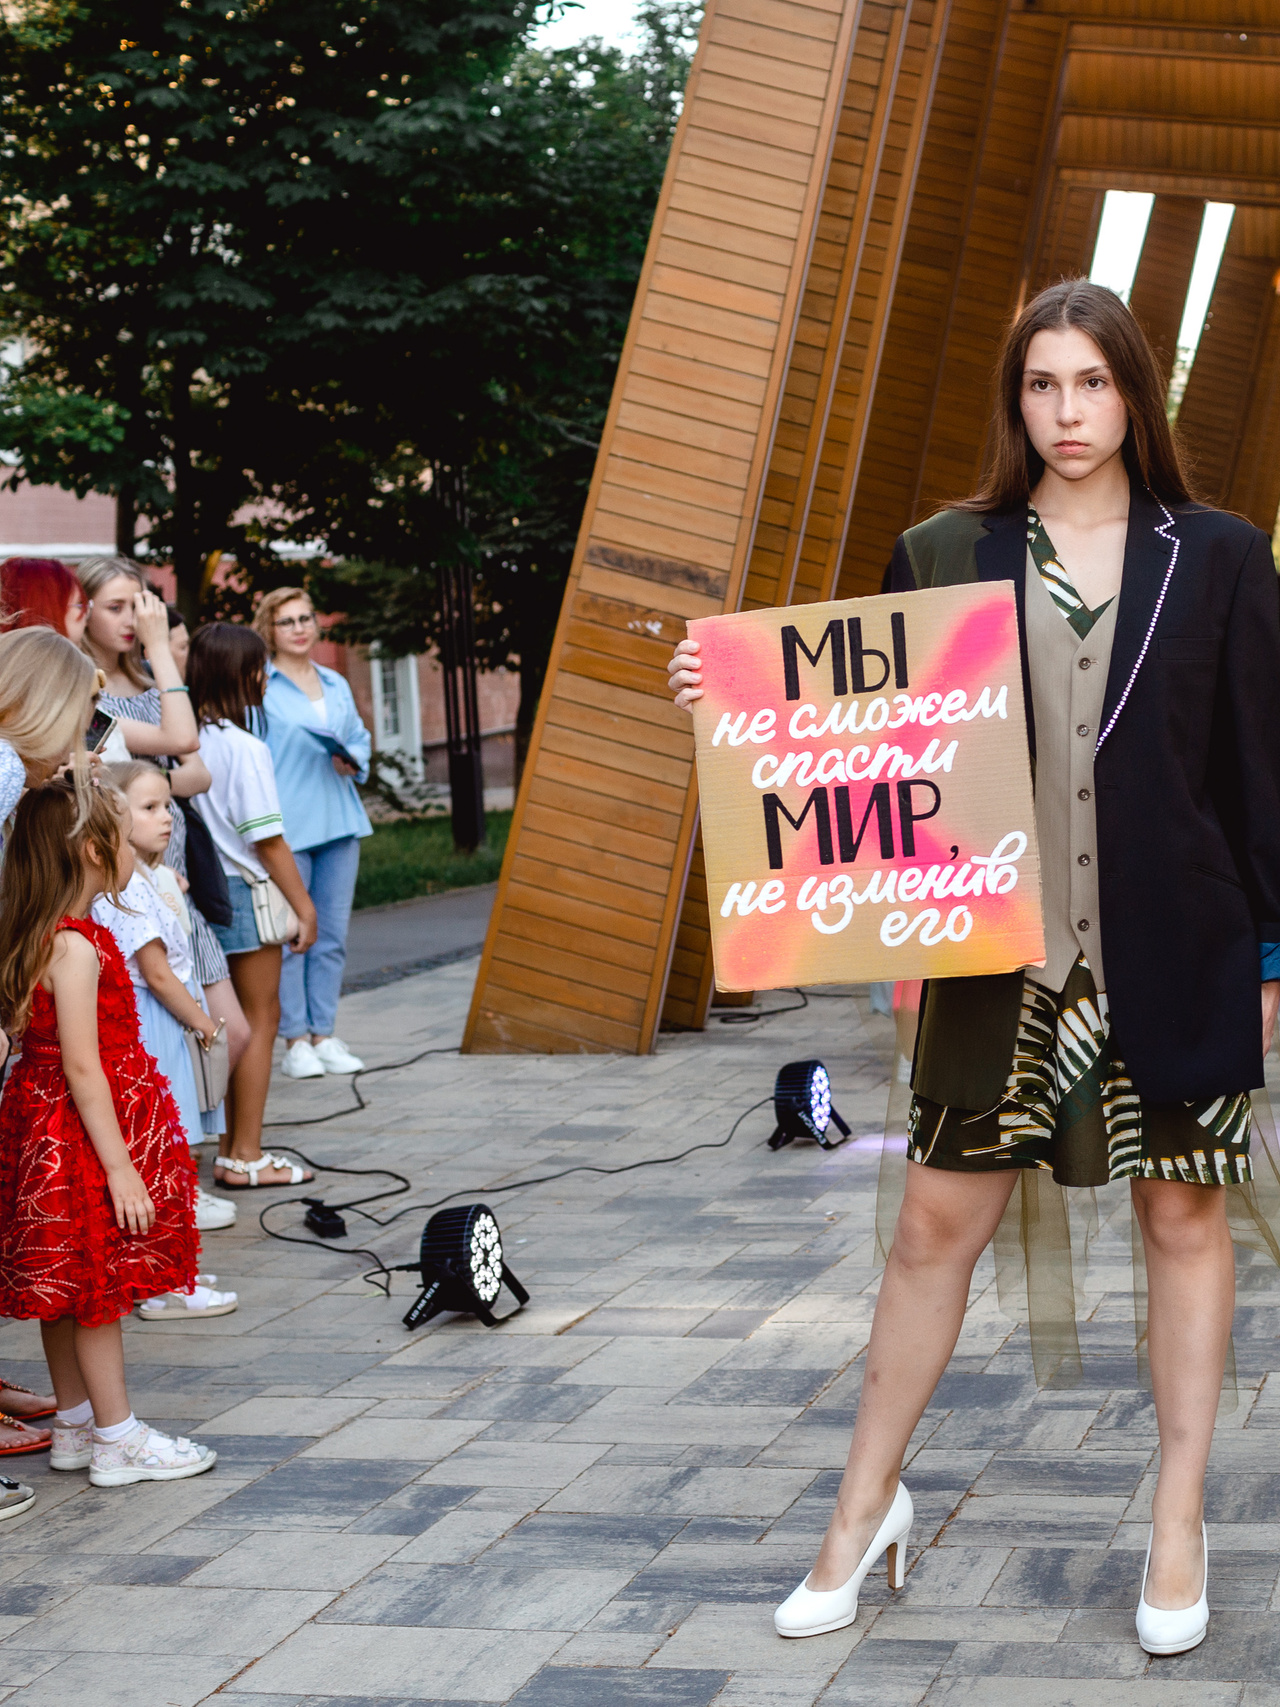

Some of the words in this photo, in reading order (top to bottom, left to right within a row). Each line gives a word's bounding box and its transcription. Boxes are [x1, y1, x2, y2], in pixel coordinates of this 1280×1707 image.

[781, 612, 908, 700] МЫ
[712, 708, 776, 746] не
[788, 685, 1008, 740] сможем
[751, 739, 959, 789] спасти
[762, 779, 959, 869] МИР,
[720, 880, 786, 917] не
[797, 831, 1027, 934] изменив
[879, 905, 973, 947] его
[409, 1309, 420, 1321] LED
[417, 1298, 428, 1310] PAR
